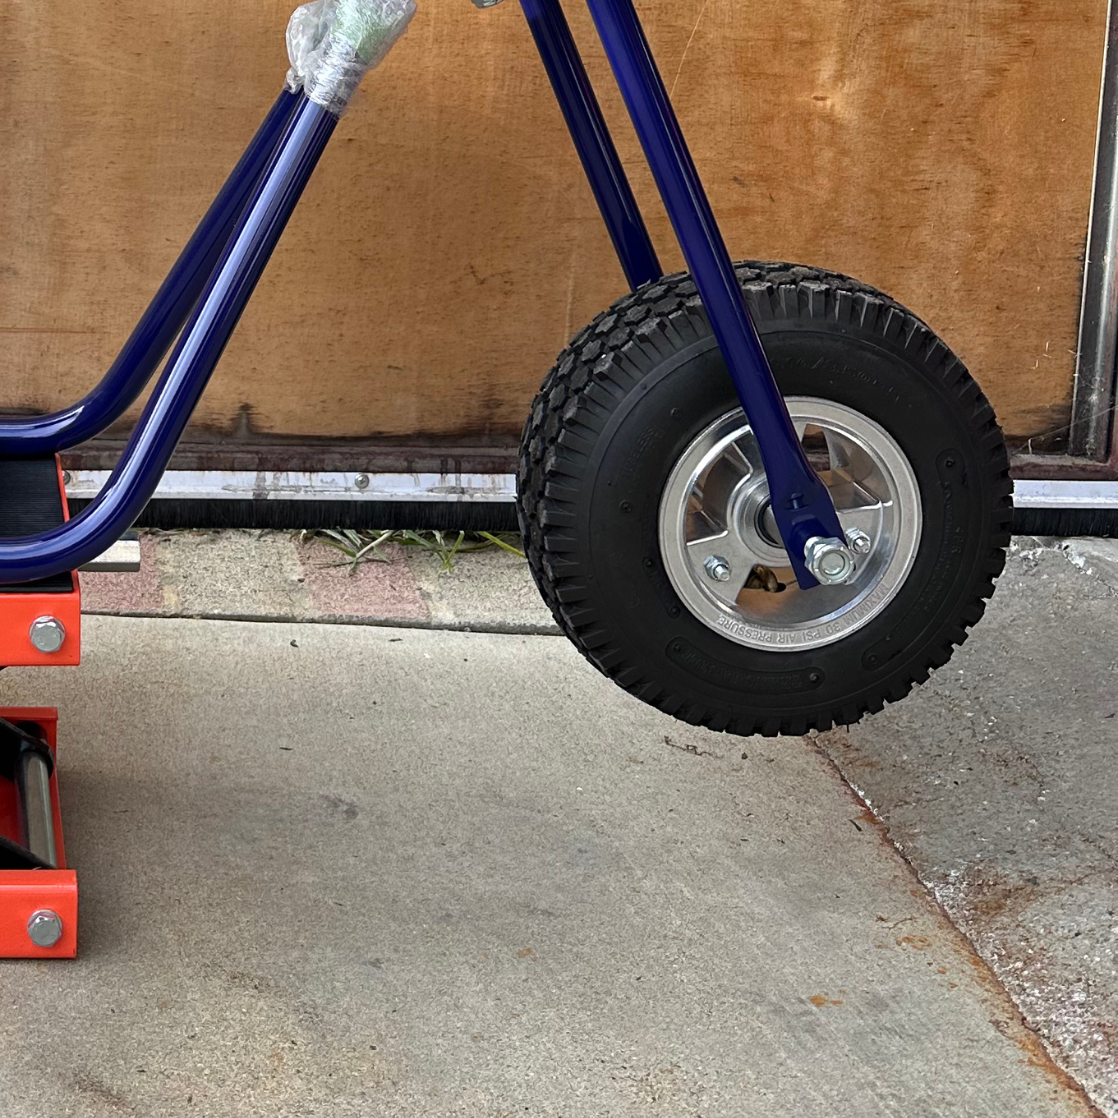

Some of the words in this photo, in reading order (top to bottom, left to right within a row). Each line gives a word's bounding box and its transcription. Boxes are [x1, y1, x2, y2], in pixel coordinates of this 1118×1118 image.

[844, 584, 890, 624] MAXIMUM
[716, 615, 772, 642] PRESSURE
[826, 622, 842, 634] 30
[776, 634, 797, 644] AIR
[803, 629, 822, 641] PSI
